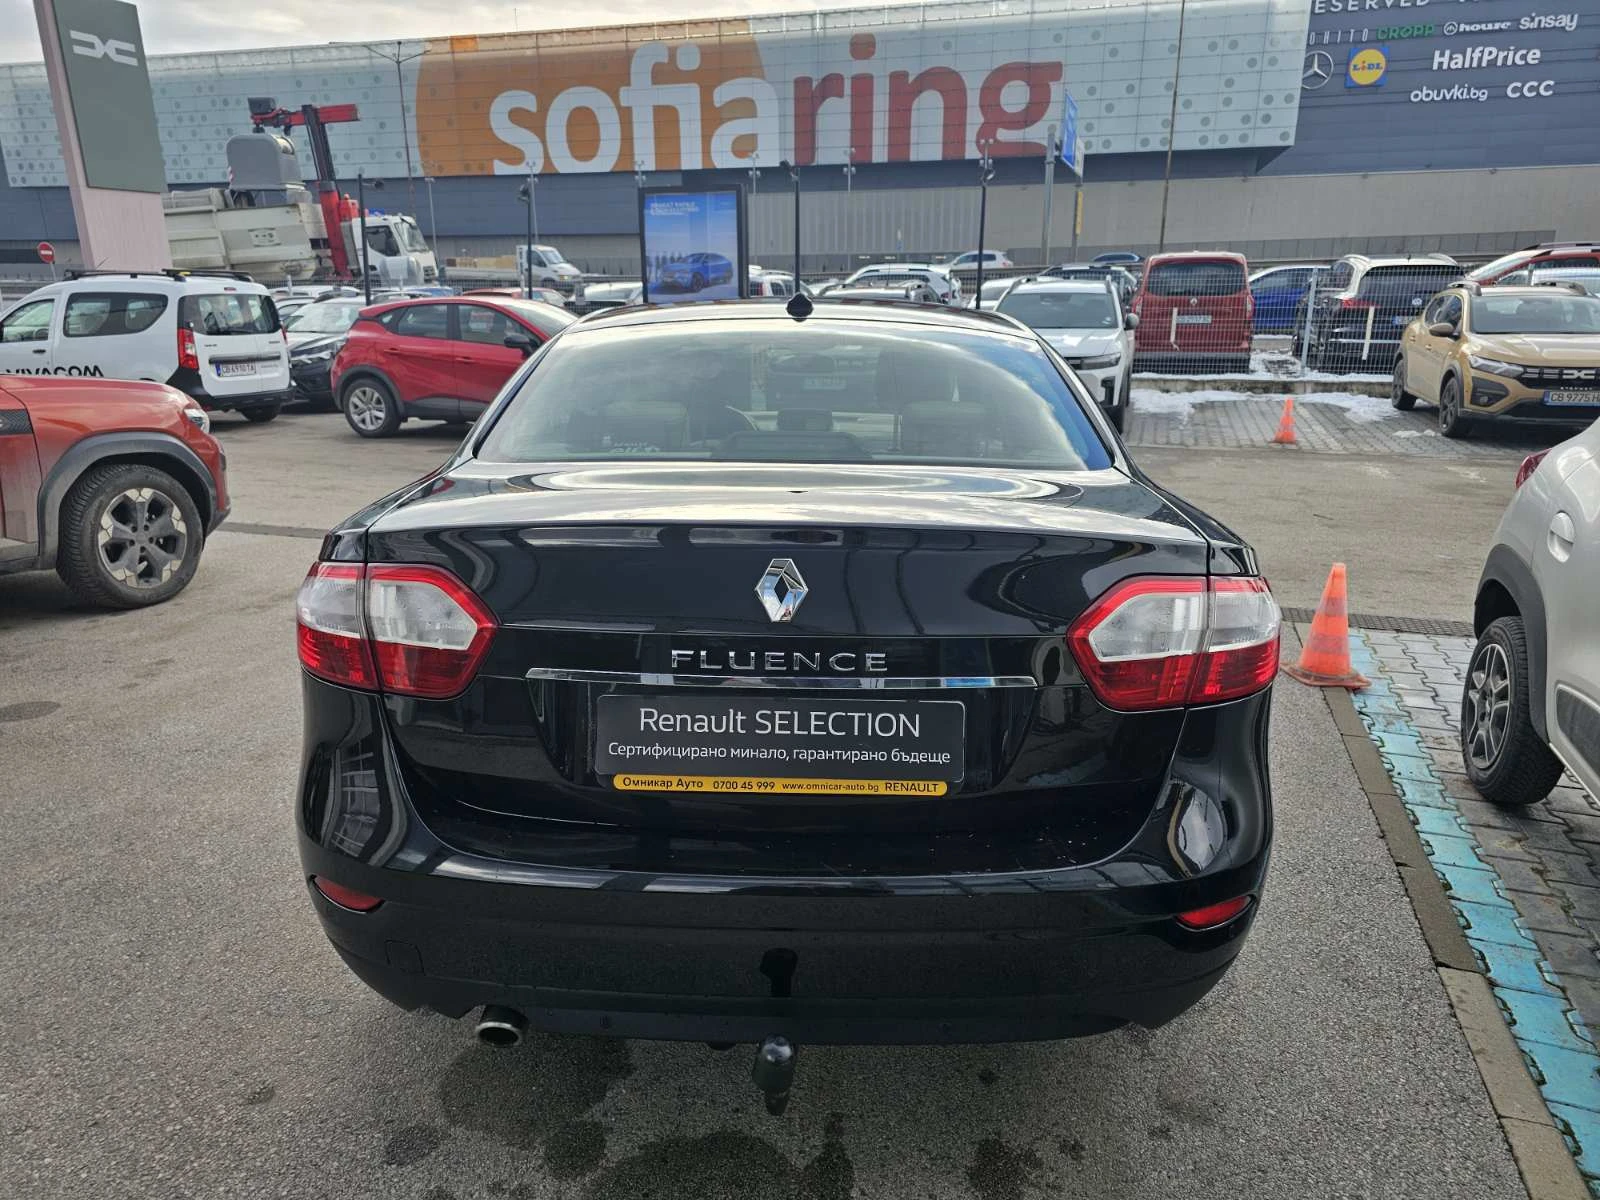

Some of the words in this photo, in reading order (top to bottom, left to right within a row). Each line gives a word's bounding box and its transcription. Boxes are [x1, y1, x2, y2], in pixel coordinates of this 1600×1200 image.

[1459, 22, 1511, 32] house
[1519, 12, 1578, 31] sinsay
[1377, 24, 1436, 40] CROPP
[1432, 46, 1541, 70] HalfPrice
[1410, 83, 1488, 102] obuvki.bg
[1506, 80, 1555, 98] CCC
[489, 33, 1062, 174] sofiaring
[671, 650, 888, 672] FLUENCE
[640, 708, 747, 734] Renault
[755, 710, 920, 738] SELECTION
[608, 742, 727, 760] Сертифицирано
[730, 748, 790, 761] минало,
[793, 749, 888, 764] гарантирано
[891, 748, 951, 765] бъдеще
[622, 777, 673, 789] Омникар
[676, 778, 704, 790] Ауто
[713, 781, 738, 790] 0700
[740, 781, 753, 790] 45
[756, 781, 775, 790] 999
[782, 782, 879, 793] www.omnicar-auto.bg
[885, 782, 939, 793] RENAULT
